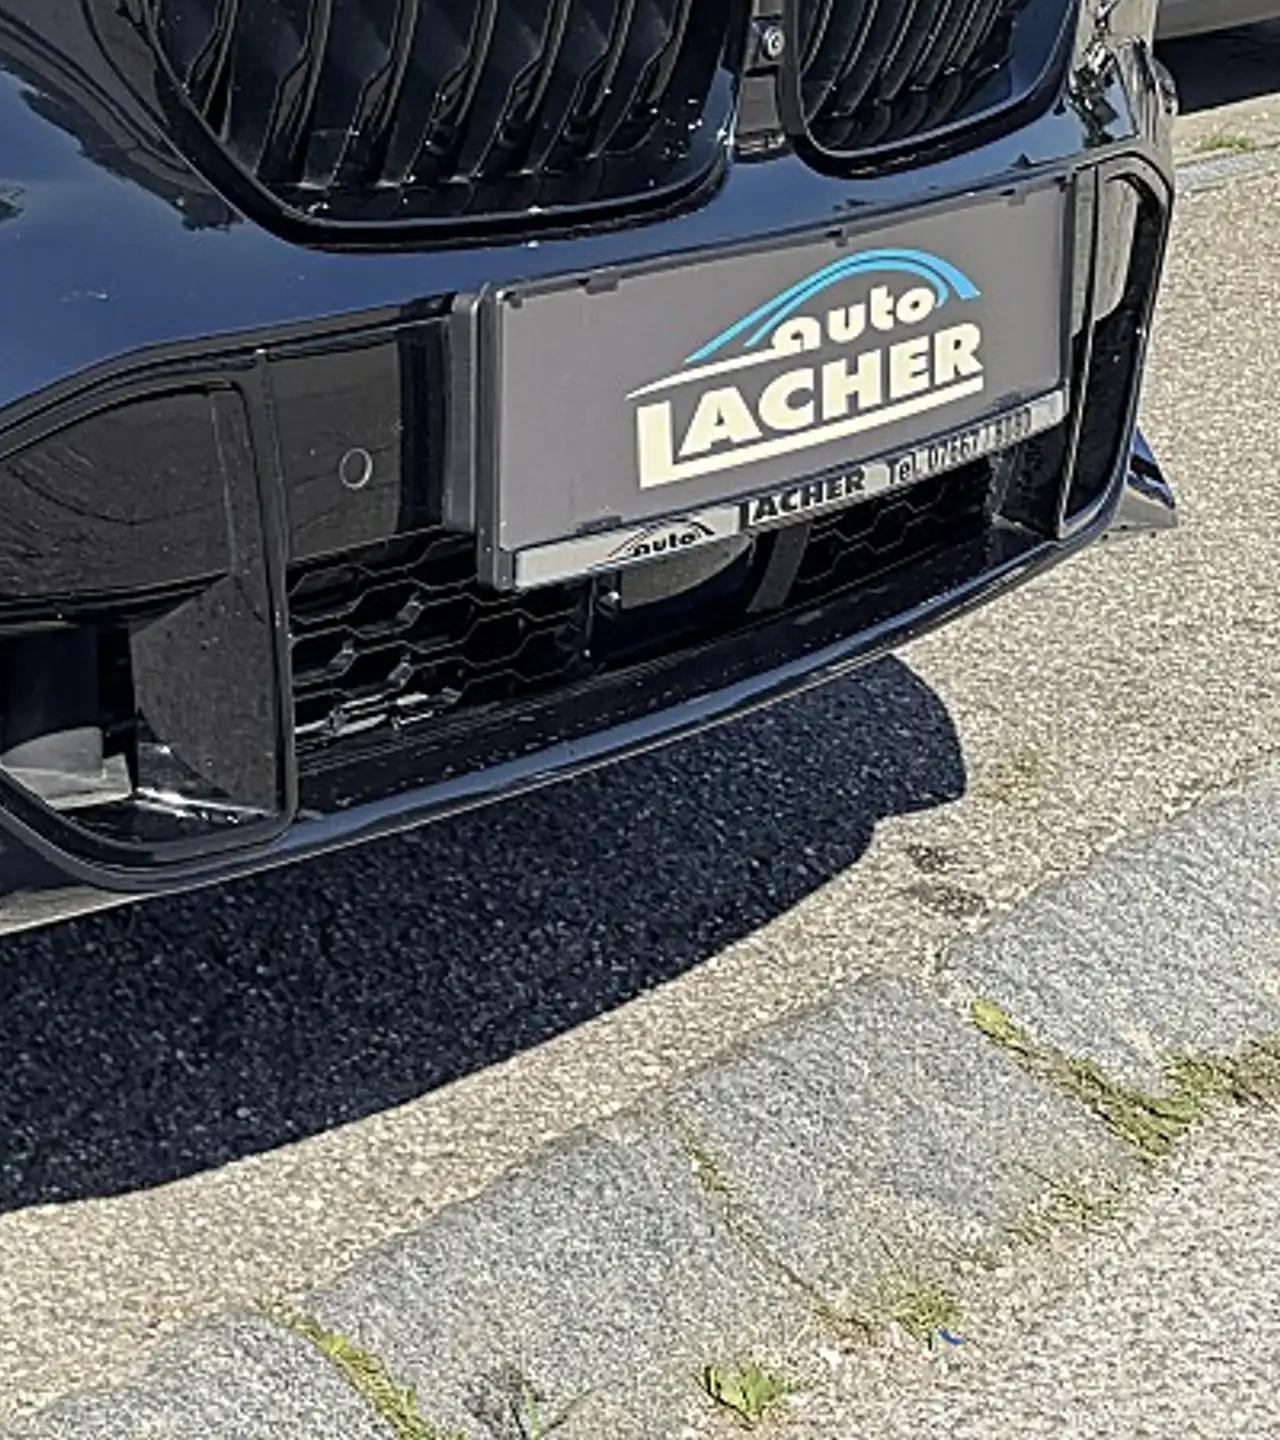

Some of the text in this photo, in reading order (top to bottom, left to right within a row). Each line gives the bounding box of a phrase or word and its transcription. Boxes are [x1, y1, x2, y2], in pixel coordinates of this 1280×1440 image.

[770, 284, 936, 354] auto
[637, 321, 984, 490] LACHER
[739, 465, 865, 530] LACHER
